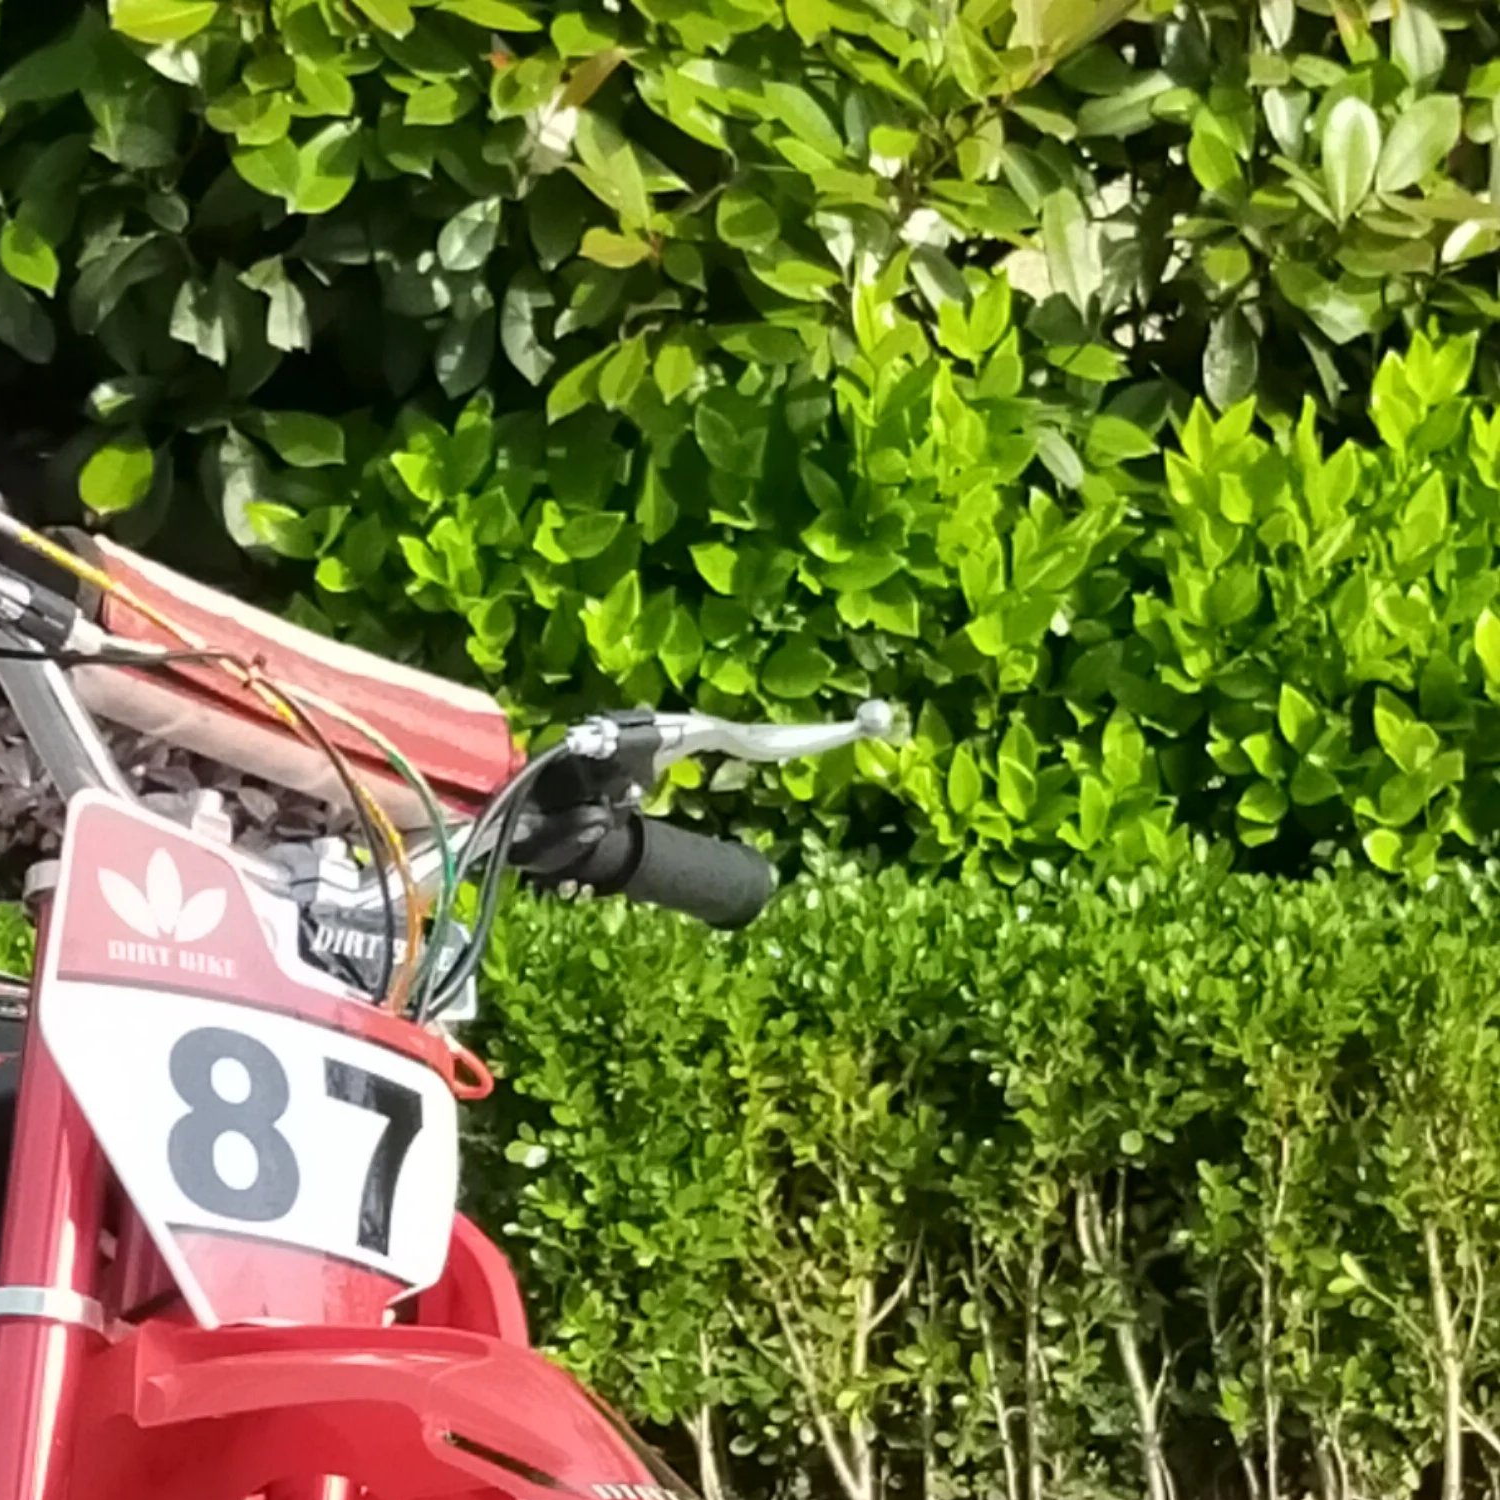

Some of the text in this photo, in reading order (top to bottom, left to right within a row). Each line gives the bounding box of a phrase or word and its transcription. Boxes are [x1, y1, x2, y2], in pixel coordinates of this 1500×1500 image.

[107, 939, 238, 979] DIRT BIKE
[311, 924, 384, 960] DIRT
[167, 1027, 424, 1257] 87
